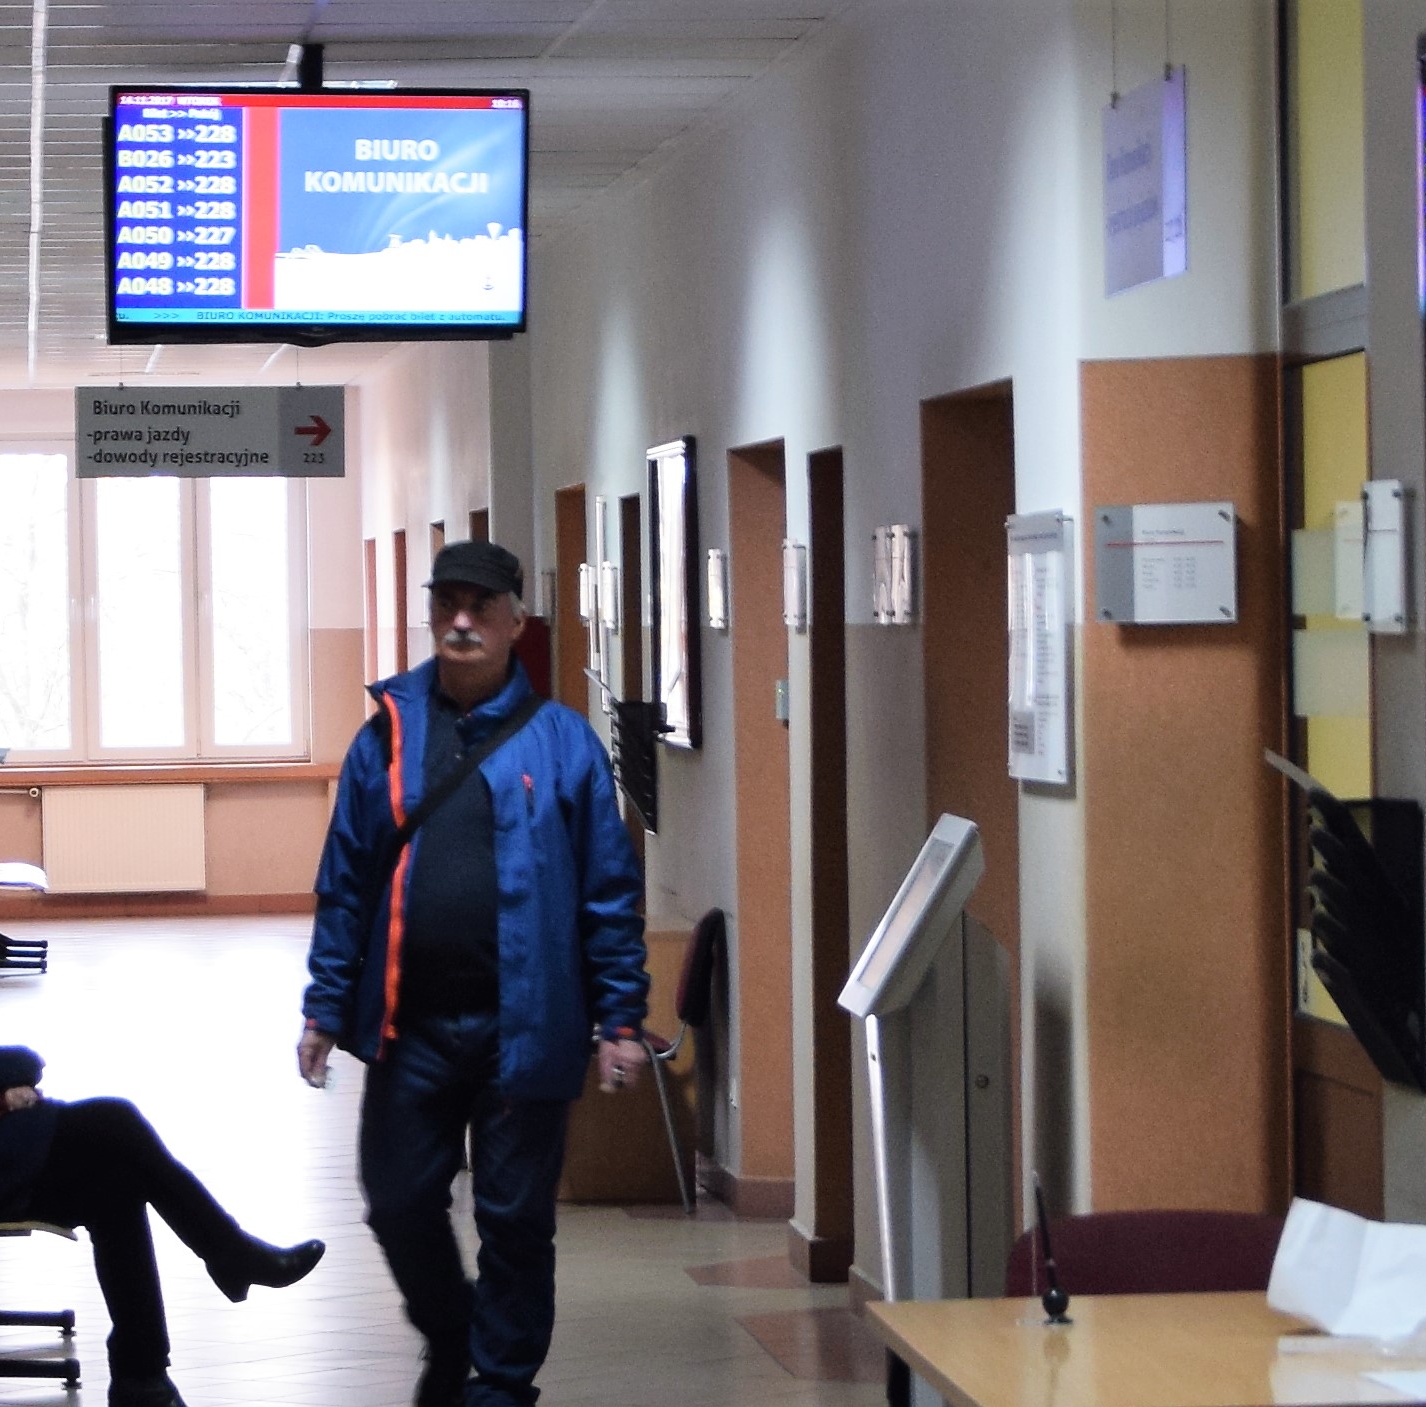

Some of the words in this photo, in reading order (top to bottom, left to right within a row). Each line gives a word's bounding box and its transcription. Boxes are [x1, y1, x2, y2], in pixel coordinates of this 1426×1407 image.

[118, 124, 174, 143] A053
[118, 150, 174, 169] B026
[355, 139, 439, 161] BIURO
[118, 175, 174, 194] A052
[305, 170, 489, 194] KOMUNIKACJI
[118, 200, 174, 219] A051
[118, 226, 174, 245] A050
[118, 252, 174, 270] A049
[118, 277, 174, 296] A048
[197, 312, 234, 320] BIURO
[238, 312, 323, 321] KOMUNIKACJI:
[93, 400, 135, 415] Biuro
[140, 400, 240, 418] Komunikacji
[87, 428, 142, 445] -prawa
[147, 426, 190, 446] jazdy
[87, 449, 158, 468] -dowody
[163, 450, 269, 468] rejestracyjne
